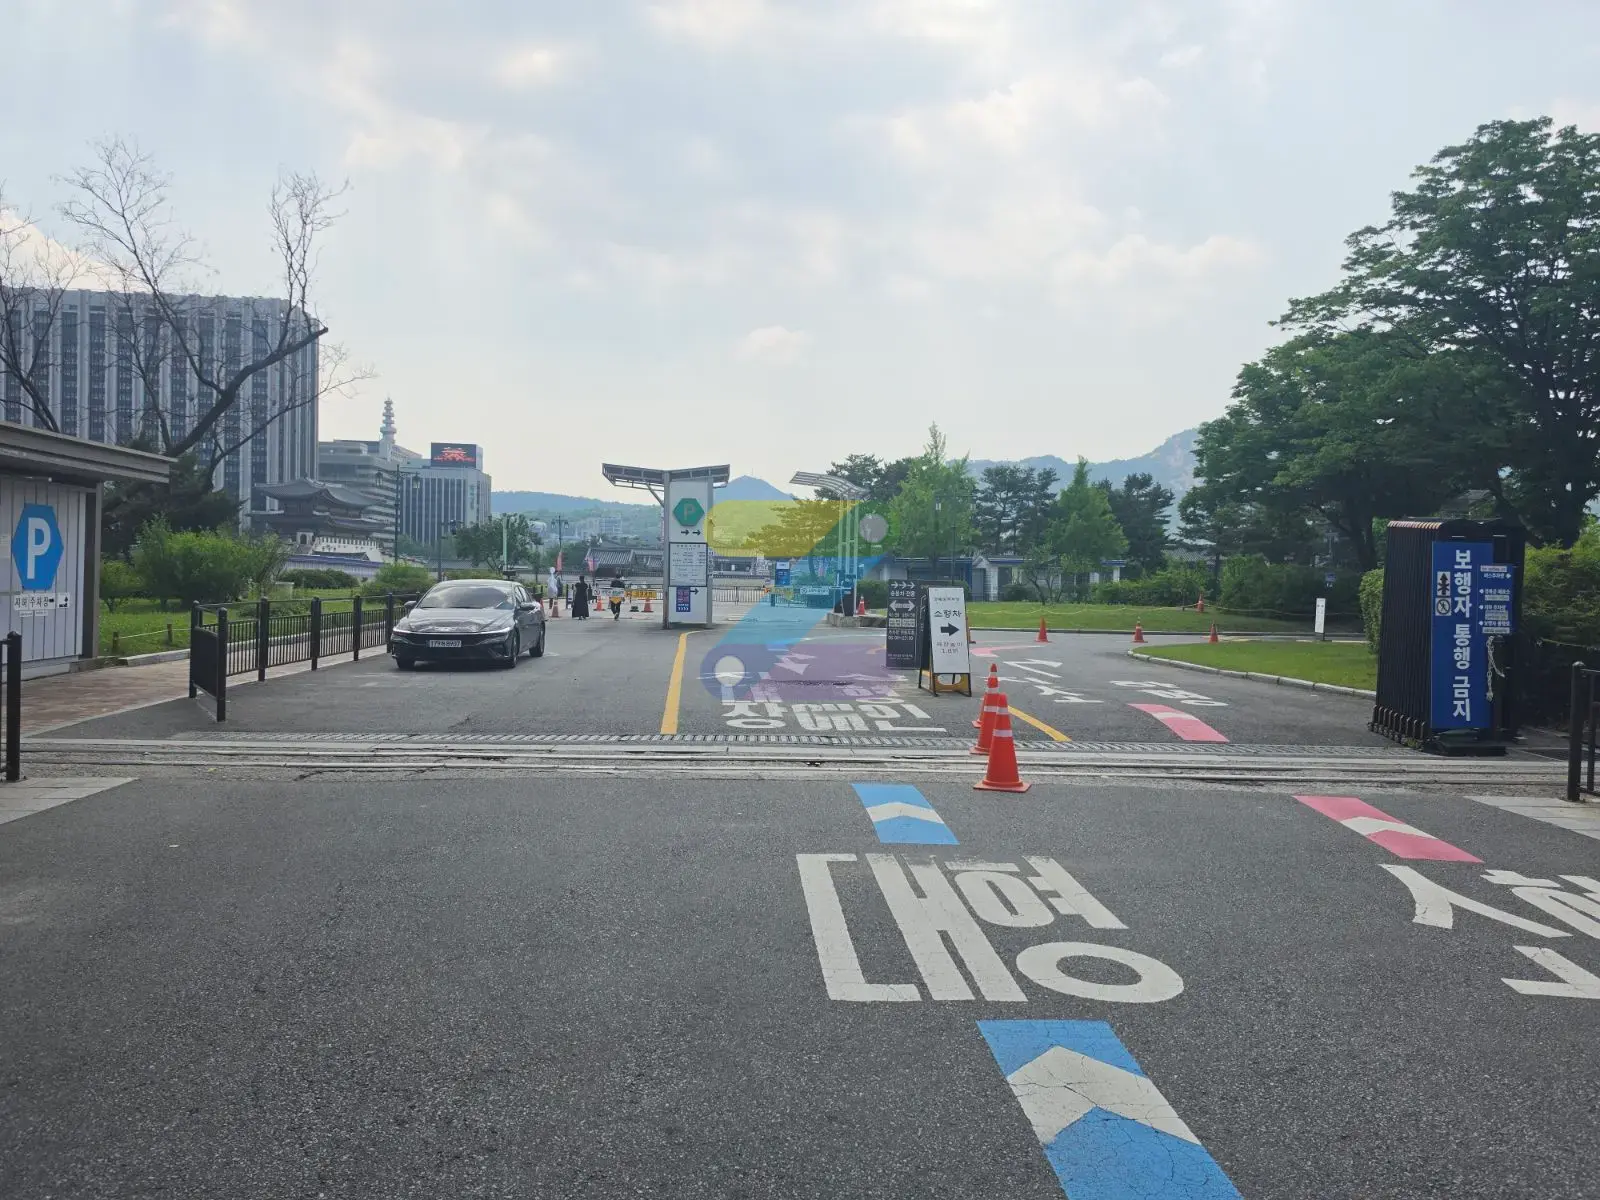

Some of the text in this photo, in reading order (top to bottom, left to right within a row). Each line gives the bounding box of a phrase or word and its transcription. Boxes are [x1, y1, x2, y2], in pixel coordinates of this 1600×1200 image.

[684, 504, 696, 520] P
[27, 517, 51, 579] P
[29, 596, 48, 607] 주차장
[934, 610, 962, 618] 소형차
[1452, 549, 1472, 722] 보행자 통행 금지
[720, 700, 948, 733] 장애인
[796, 853, 1185, 1004] 대형
